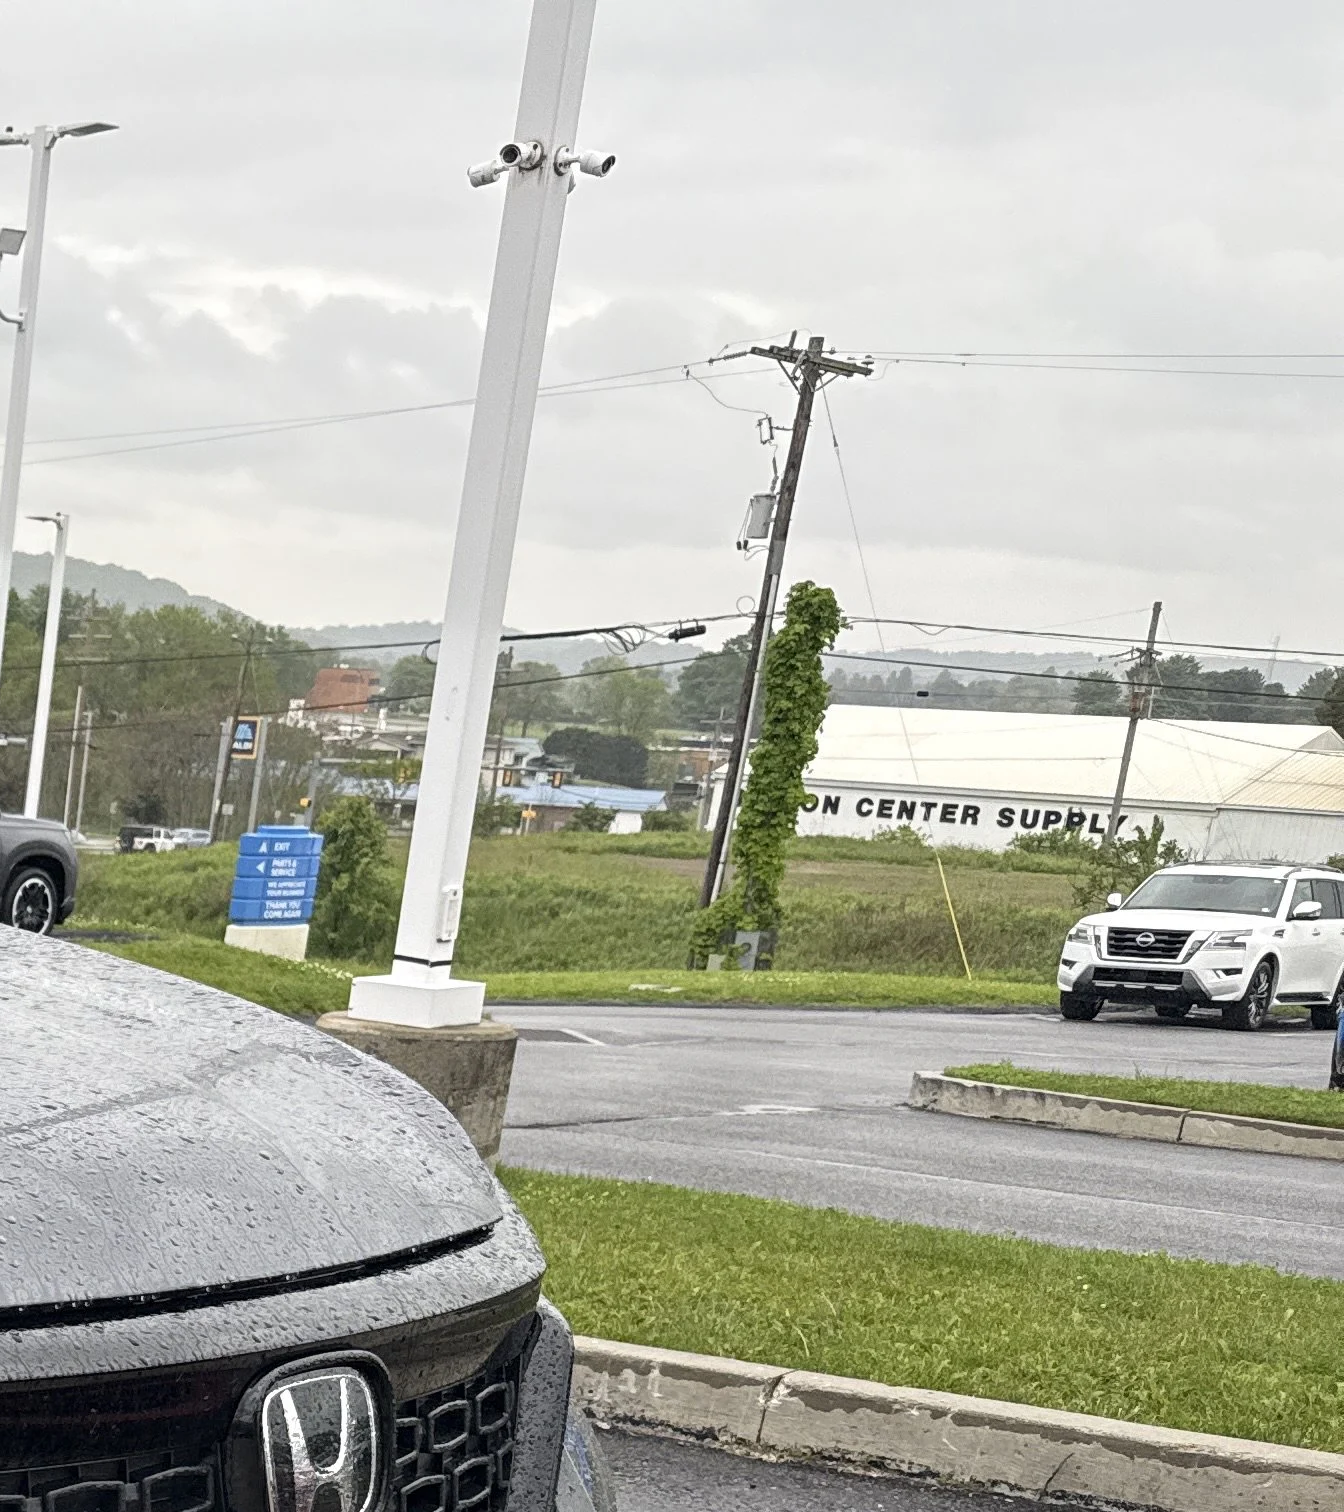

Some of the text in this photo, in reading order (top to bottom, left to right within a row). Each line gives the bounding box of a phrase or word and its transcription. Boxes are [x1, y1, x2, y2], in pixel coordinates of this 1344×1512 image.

[855, 797, 980, 826] CENTER
[996, 807, 1128, 835] SUPPLY
[274, 842, 290, 851] EXIT
